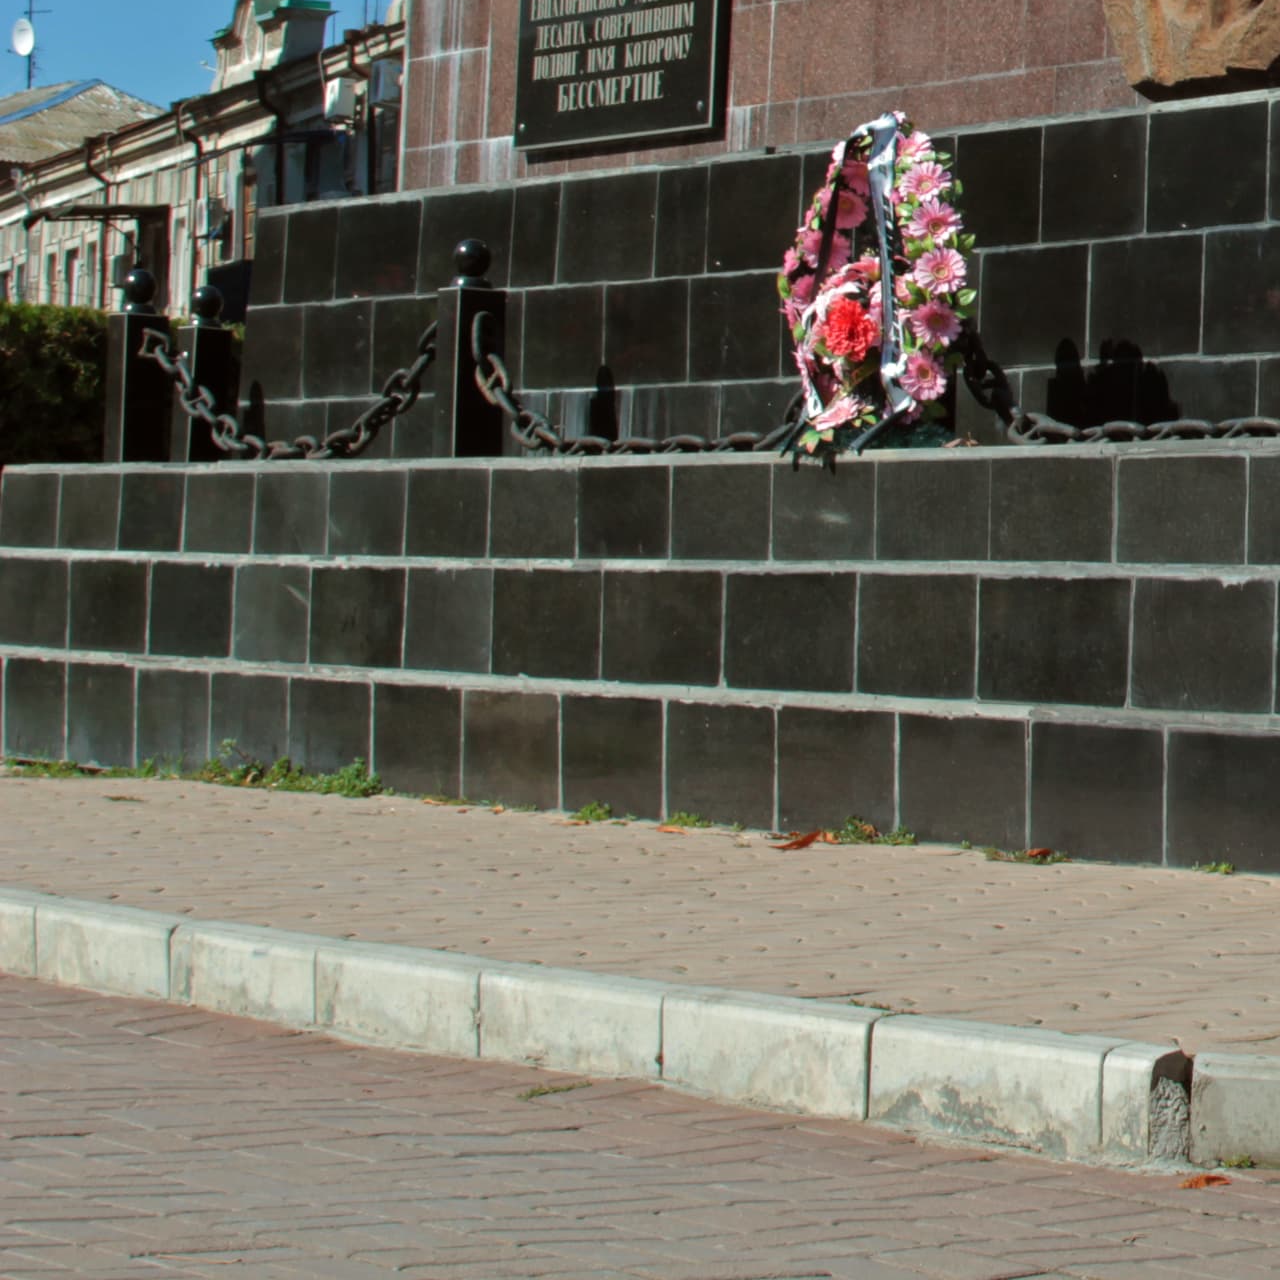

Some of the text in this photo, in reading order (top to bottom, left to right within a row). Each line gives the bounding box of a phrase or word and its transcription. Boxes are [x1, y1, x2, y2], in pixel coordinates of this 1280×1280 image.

[594, 1, 695, 42] СОВЕРШИВШИМ
[587, 45, 616, 73] ИМЯ
[624, 33, 693, 68] КОТОРОМУ
[557, 70, 665, 112] БЕССМЕРТИЕ
